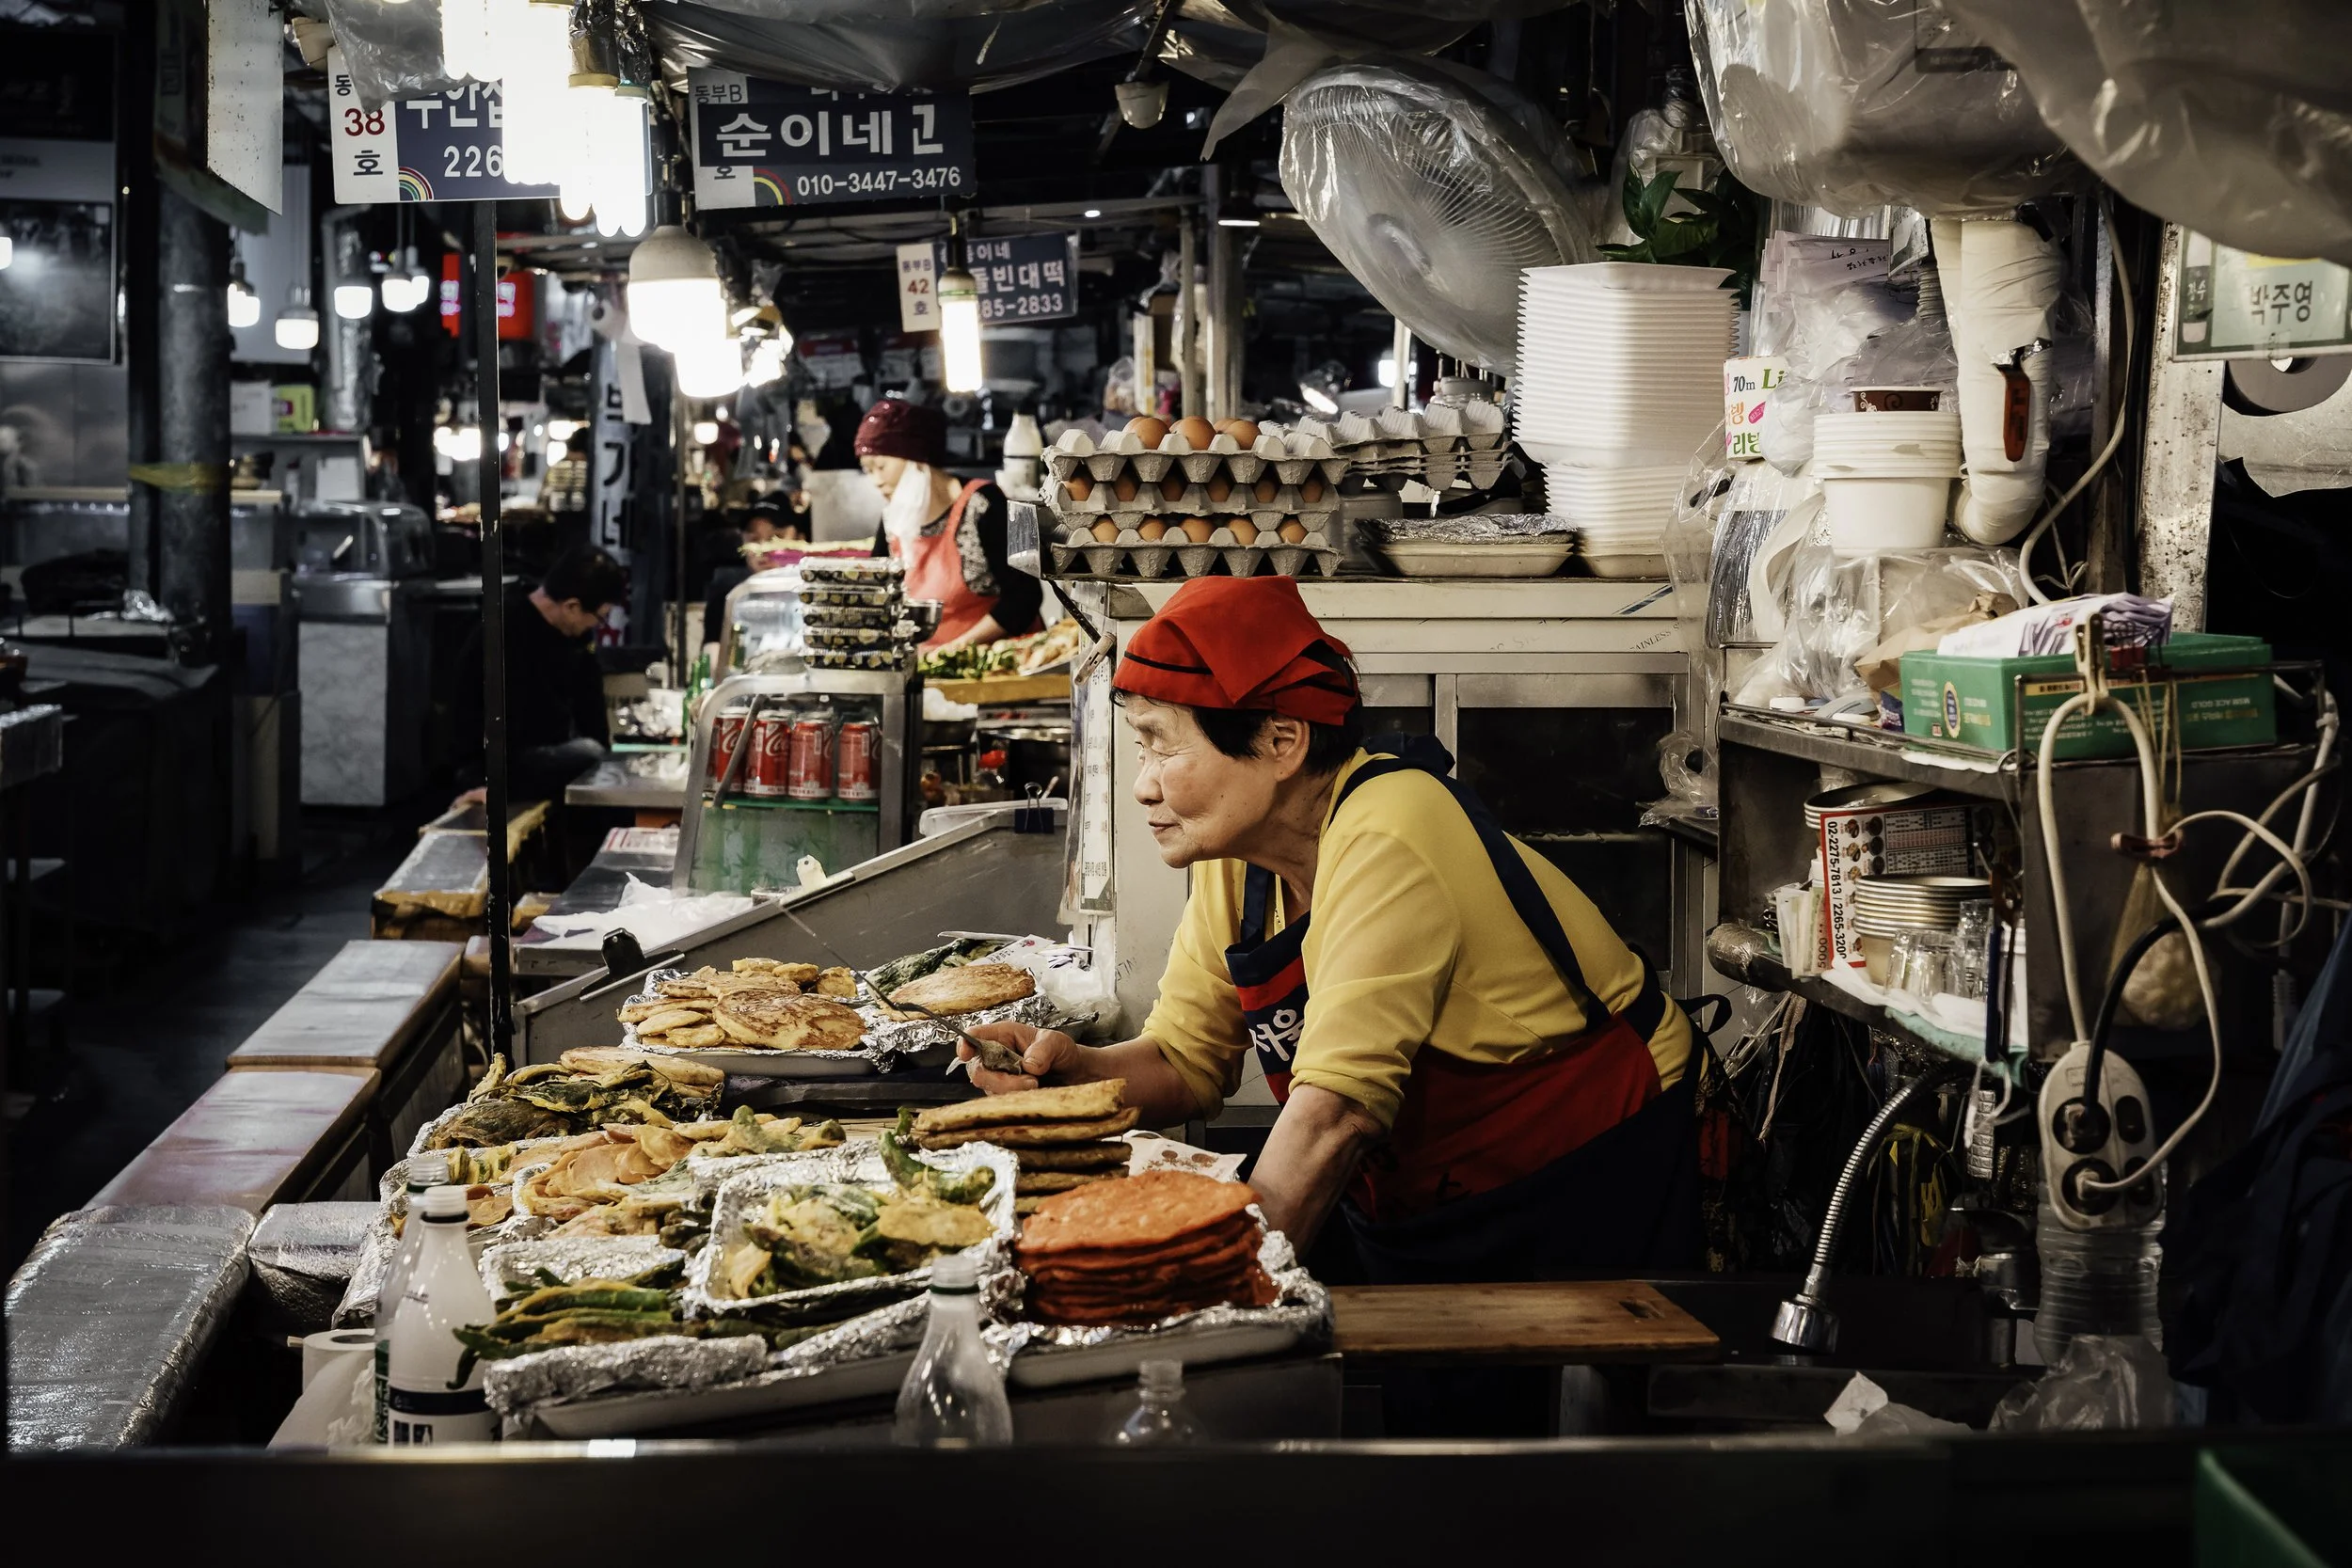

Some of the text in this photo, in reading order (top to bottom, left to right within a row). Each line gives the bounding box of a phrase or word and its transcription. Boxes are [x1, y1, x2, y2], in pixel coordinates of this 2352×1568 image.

[694, 84, 742, 104] 동부B
[344, 107, 386, 137] 38
[716, 110, 893, 157] 순이네
[353, 150, 384, 176] 호
[797, 166, 961, 197] 010-3447-3476
[906, 278, 930, 295] 42
[913, 300, 930, 316] 호
[1733, 375, 1756, 393] 70m
[1827, 820, 1842, 895] 02-2275-7813
[1817, 937, 1828, 969] 5000
